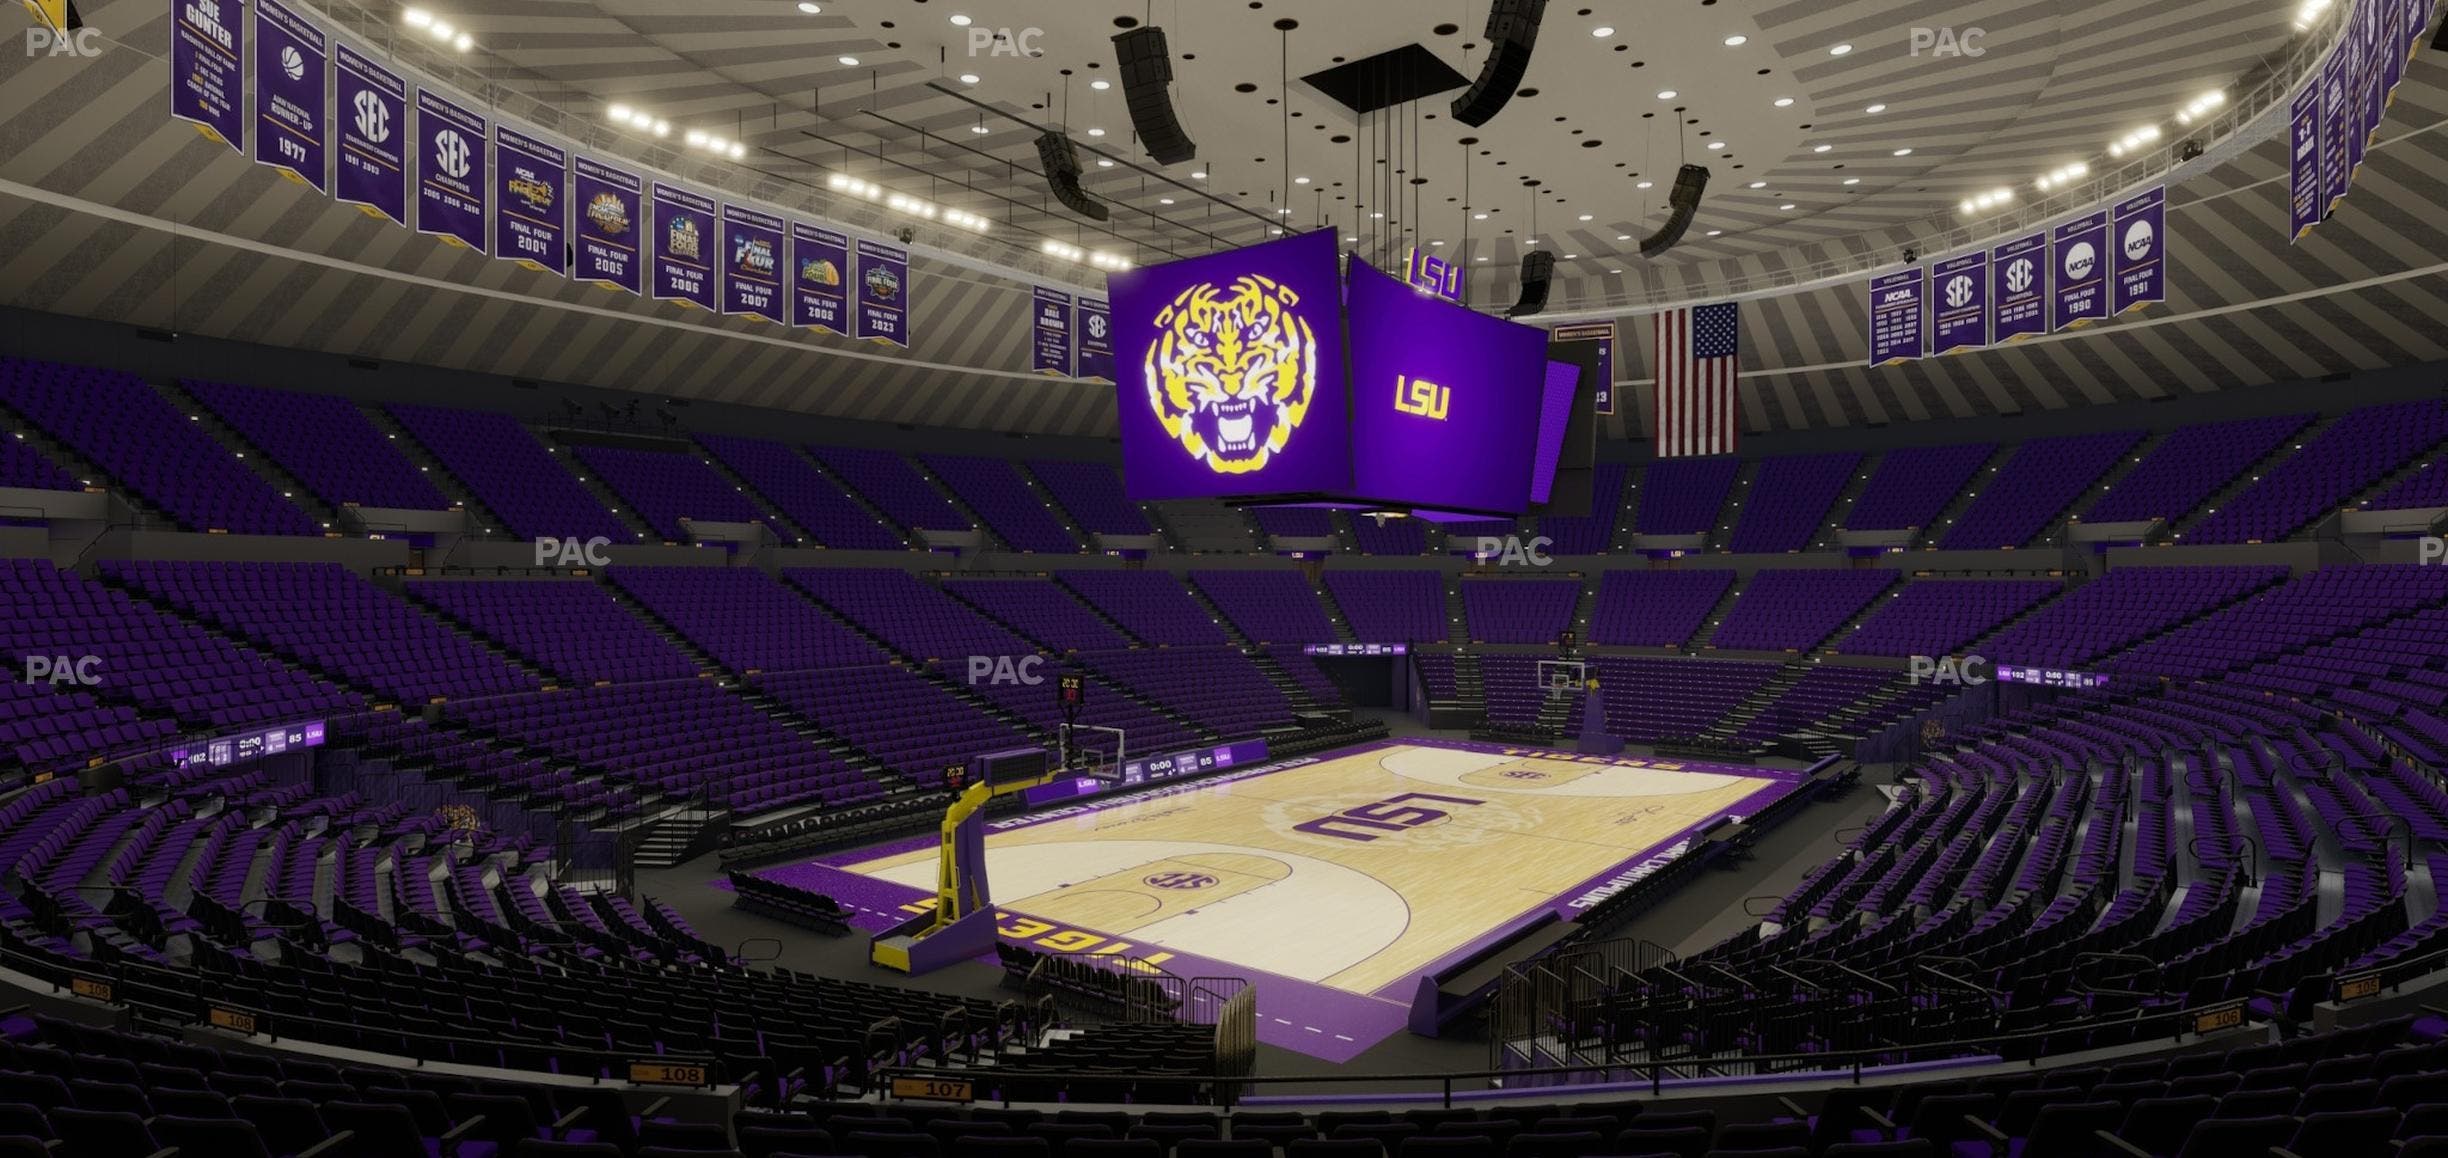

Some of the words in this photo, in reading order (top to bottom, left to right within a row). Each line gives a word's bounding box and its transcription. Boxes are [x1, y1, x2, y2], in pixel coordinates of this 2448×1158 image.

[199, 0, 220, 23] SUE
[186, 3, 233, 49] GUNTER
[260, 0, 289, 25] WOMEN'S
[289, 18, 323, 47] BASKETBALL
[354, 90, 390, 144] SEC
[279, 137, 306, 163] 1977
[435, 129, 471, 179] SEC
[435, 173, 470, 193] CHAMPIONS
[510, 221, 532, 235] FINAL
[534, 229, 552, 241] FOUR
[518, 235, 547, 255] 2004
[2127, 236, 2152, 253] NCAA
[588, 245, 608, 257] FINAL
[610, 250, 628, 262] FOUR
[595, 258, 623, 275] 2005
[665, 265, 684, 276] FINAL
[686, 269, 703, 280] FOUR
[2069, 257, 2094, 272] NCAA
[1405, 247, 1464, 301] LSU
[2006, 258, 2033, 292] SEC
[2123, 274, 2139, 285] FINAL
[2139, 269, 2153, 280] FOUR
[671, 277, 699, 294] 2006
[735, 282, 754, 292] FINAL
[755, 285, 773, 296] FOUR
[1945, 275, 1973, 307] SEC
[2129, 281, 2148, 296] 1991
[741, 293, 768, 308] 2007
[803, 296, 820, 306] FINAL
[822, 300, 838, 309] FOUR
[1885, 289, 1911, 303] NCAA
[2064, 291, 2080, 302] FINAL
[2080, 288, 2095, 299] FOUR
[808, 307, 834, 321] 2008
[2069, 299, 2091, 314] 1990
[867, 309, 882, 318] FINAL
[883, 313, 898, 322] FOUR
[872, 320, 894, 333] 2023
[1395, 375, 1450, 419] LSU
[239, 737, 261, 749] 0:00
[289, 733, 302, 743] 85
[1200, 757, 1212, 766] 85
[1216, 753, 1231, 762] LSU
[1150, 760, 1172, 772] 0:00
[1077, 778, 1097, 788] LSU
[1292, 792, 1487, 842] LSU
[1149, 872, 1215, 890] SEC
[88, 984, 110, 999] 108
[229, 1014, 253, 1031] 108
[2215, 1010, 2239, 1027] 106
[661, 1067, 701, 1083] 108
[925, 1082, 966, 1098] 107
